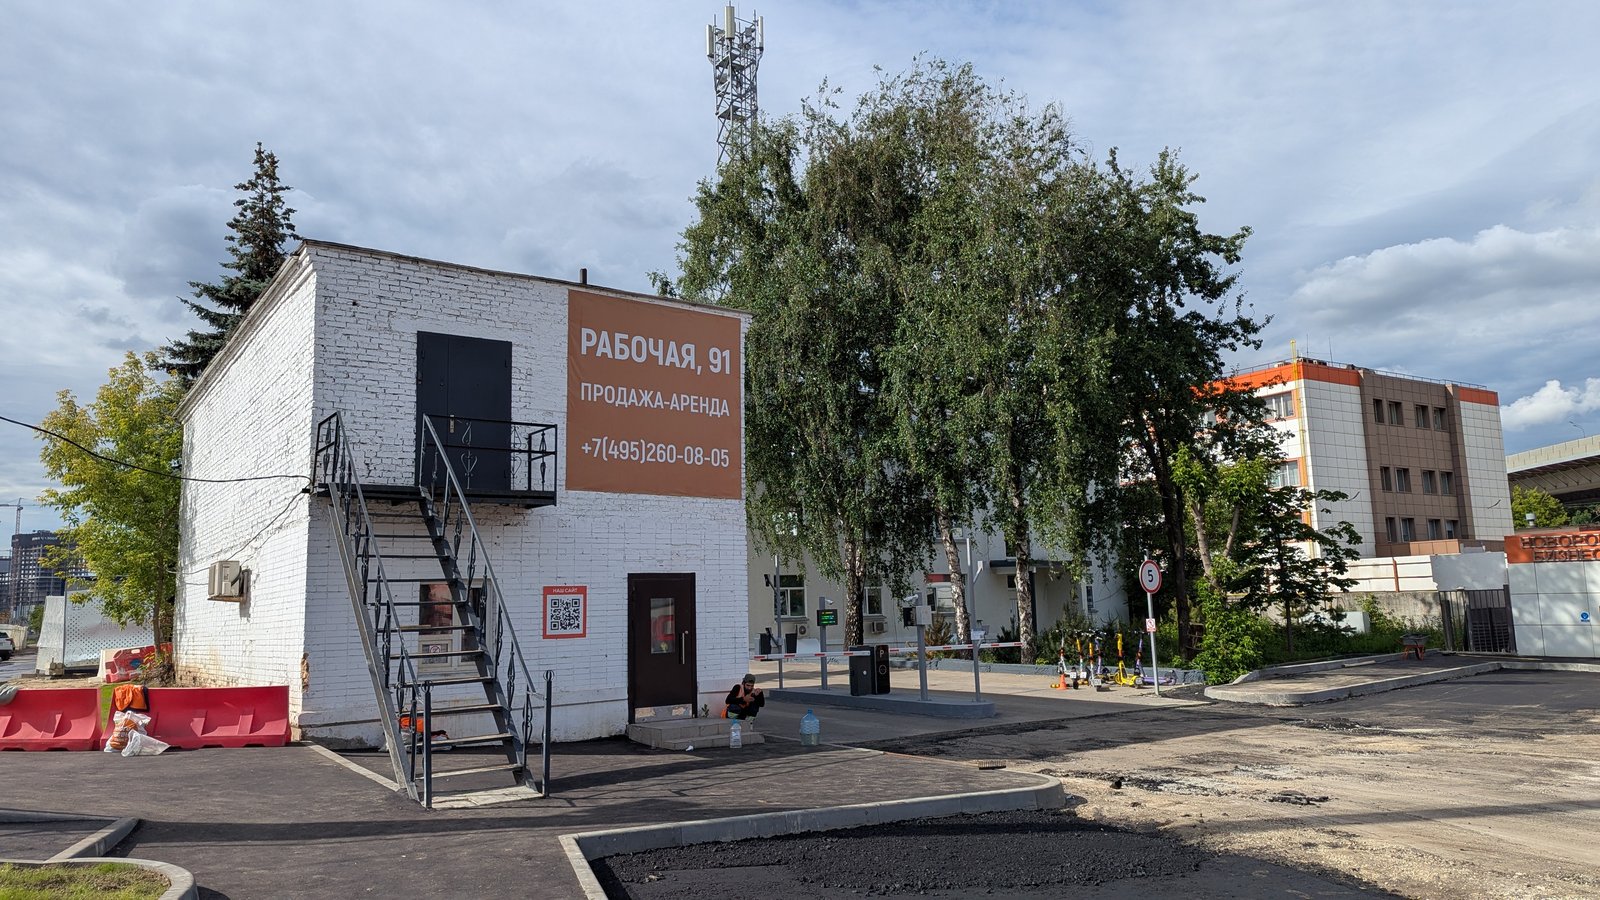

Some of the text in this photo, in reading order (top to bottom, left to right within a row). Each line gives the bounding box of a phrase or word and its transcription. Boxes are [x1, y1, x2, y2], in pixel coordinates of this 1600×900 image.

[581, 327, 731, 375] РАБОЧАЯ, 91
[580, 382, 730, 418] ПРОДАЖА-АРЕНДА
[581, 436, 729, 467] +7(495)260-08-05
[1520, 533, 1600, 549] НОВОРО
[1147, 569, 1154, 583] 5
